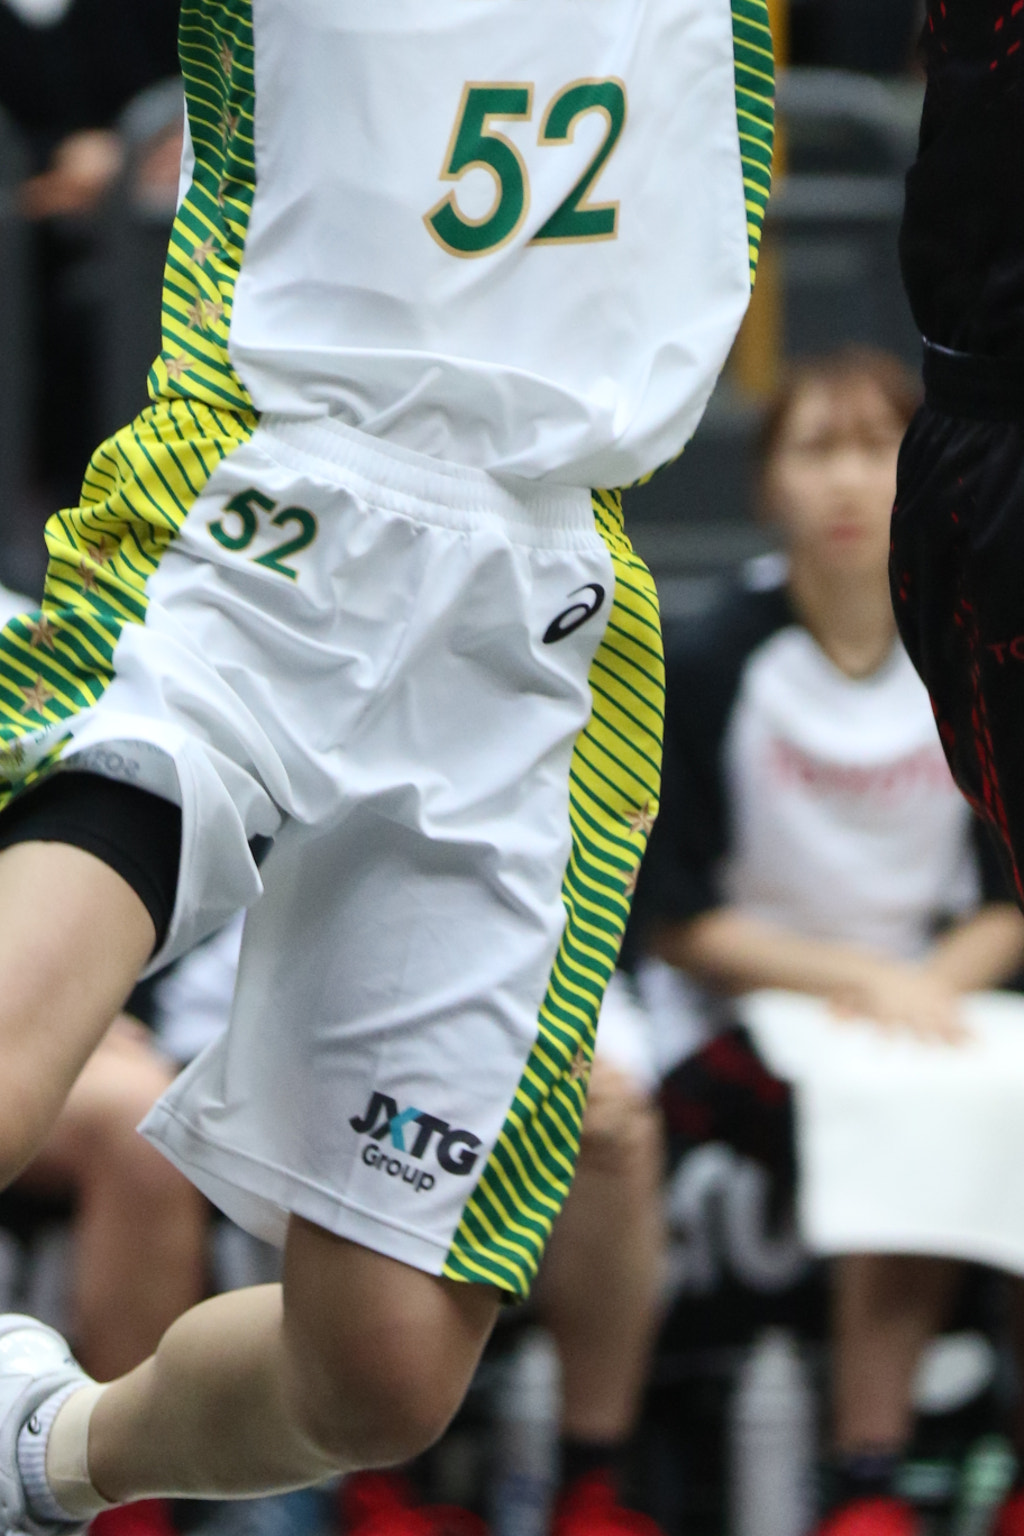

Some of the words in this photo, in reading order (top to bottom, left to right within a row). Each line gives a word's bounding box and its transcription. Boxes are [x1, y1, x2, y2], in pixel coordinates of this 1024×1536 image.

[422, 76, 629, 259] 52
[207, 487, 319, 584] 52
[349, 1091, 483, 1176] JXTG
[362, 1144, 436, 1192] Group
